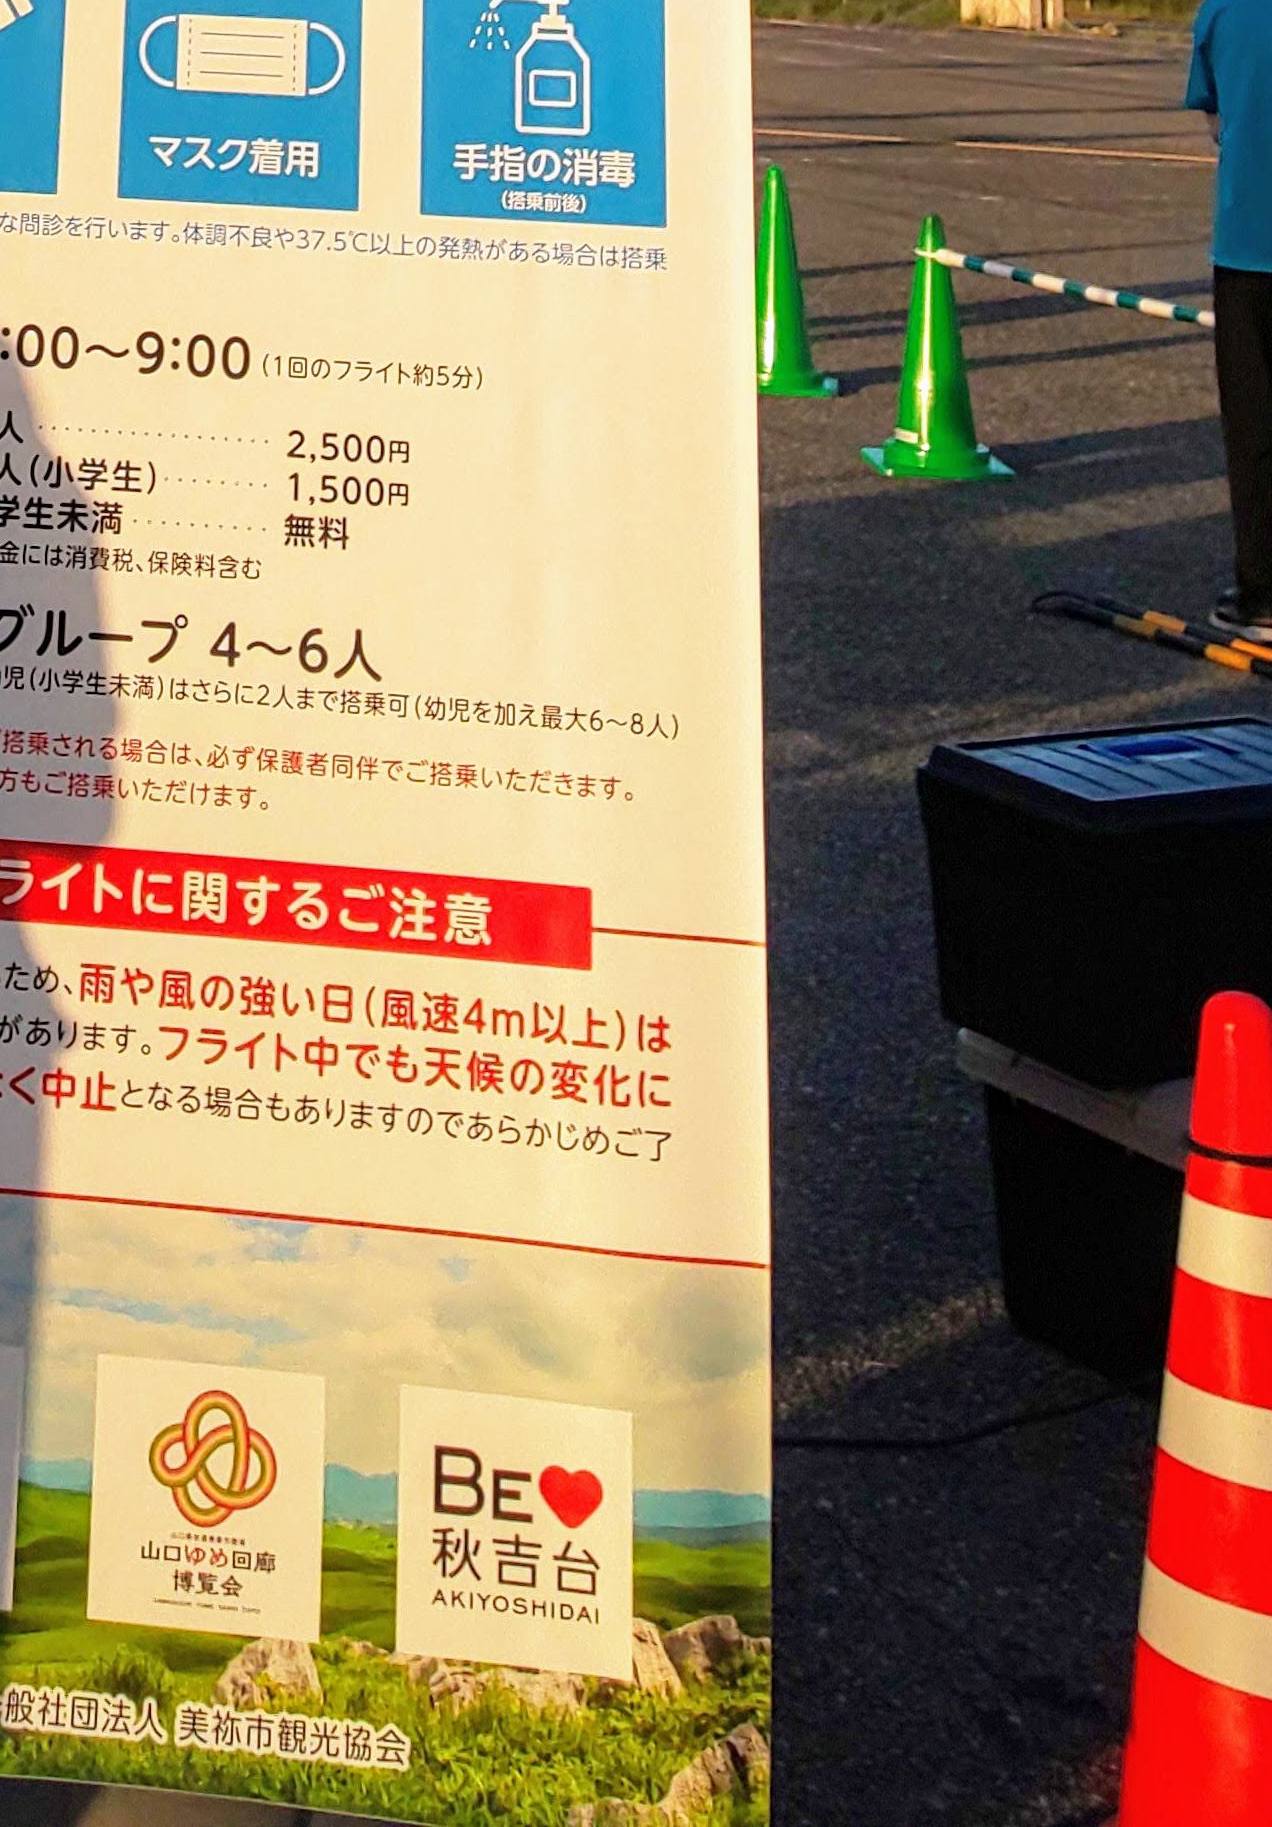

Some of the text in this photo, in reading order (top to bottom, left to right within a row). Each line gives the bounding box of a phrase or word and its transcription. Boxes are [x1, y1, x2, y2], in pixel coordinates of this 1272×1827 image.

[151, 133, 321, 180] マスク着用
[452, 143, 638, 190] 手指の消毒
[286, 429, 411, 465] 2,500円
[287, 472, 410, 508] 1,500円
[284, 513, 350, 551] 無料
[140, 1540, 277, 1575] 山口ゆめ回廊
[432, 1526, 601, 1596] 秋吉台
[172, 1568, 244, 1597] 博覧会
[431, 1588, 600, 1625] AKIYOSHIDAI
[178, 1705, 408, 1767] 美祢市観光協会
